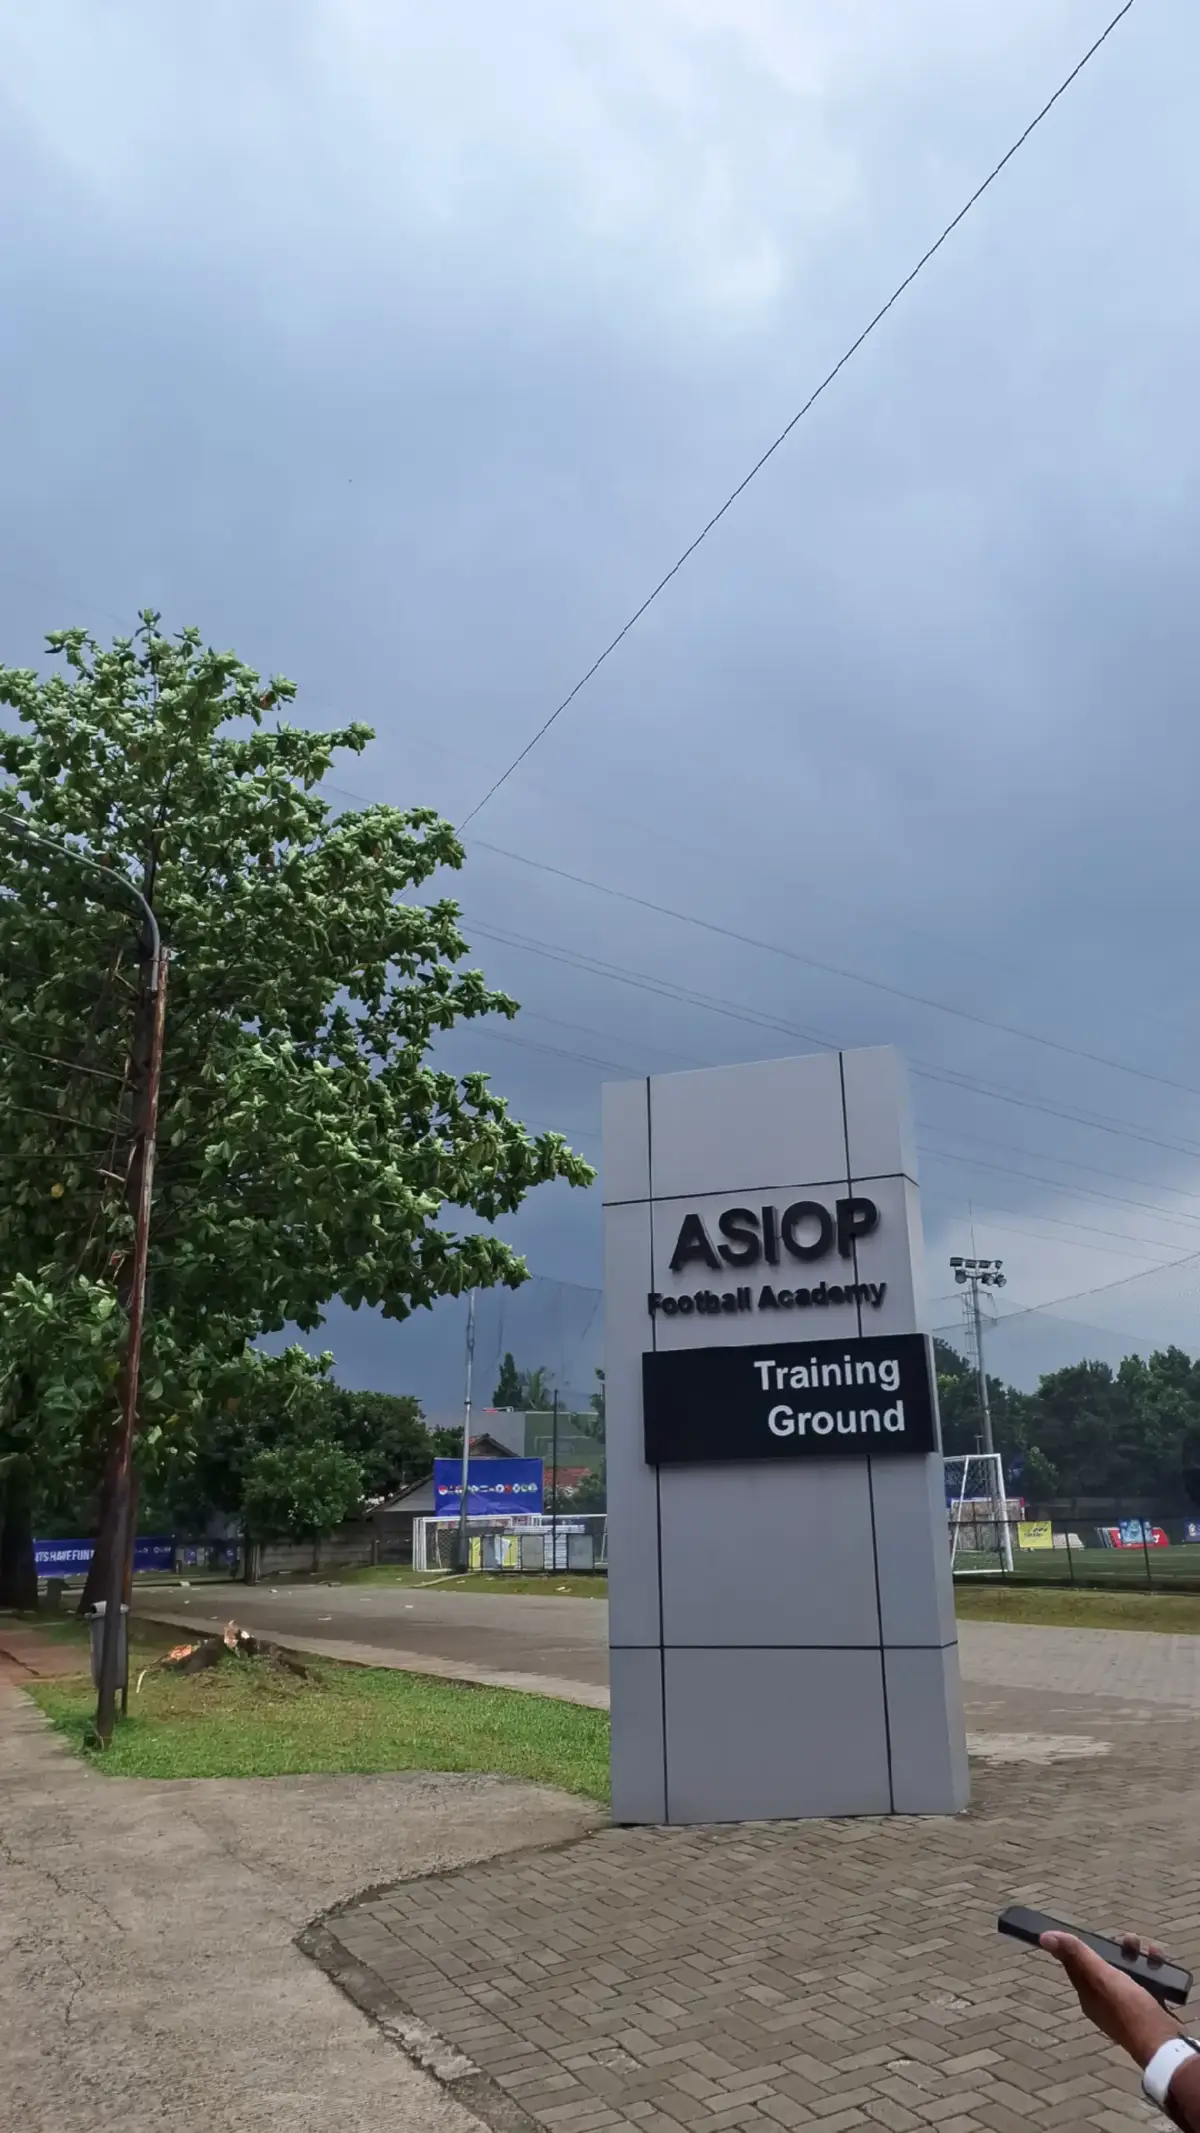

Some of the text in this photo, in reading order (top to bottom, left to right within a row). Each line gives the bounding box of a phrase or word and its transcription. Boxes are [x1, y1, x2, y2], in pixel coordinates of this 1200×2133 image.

[669, 1197, 879, 1270] ASIOP
[648, 1281, 886, 1315] Football Academy
[754, 1355, 900, 1391] Training
[768, 1400, 905, 1436] Ground
